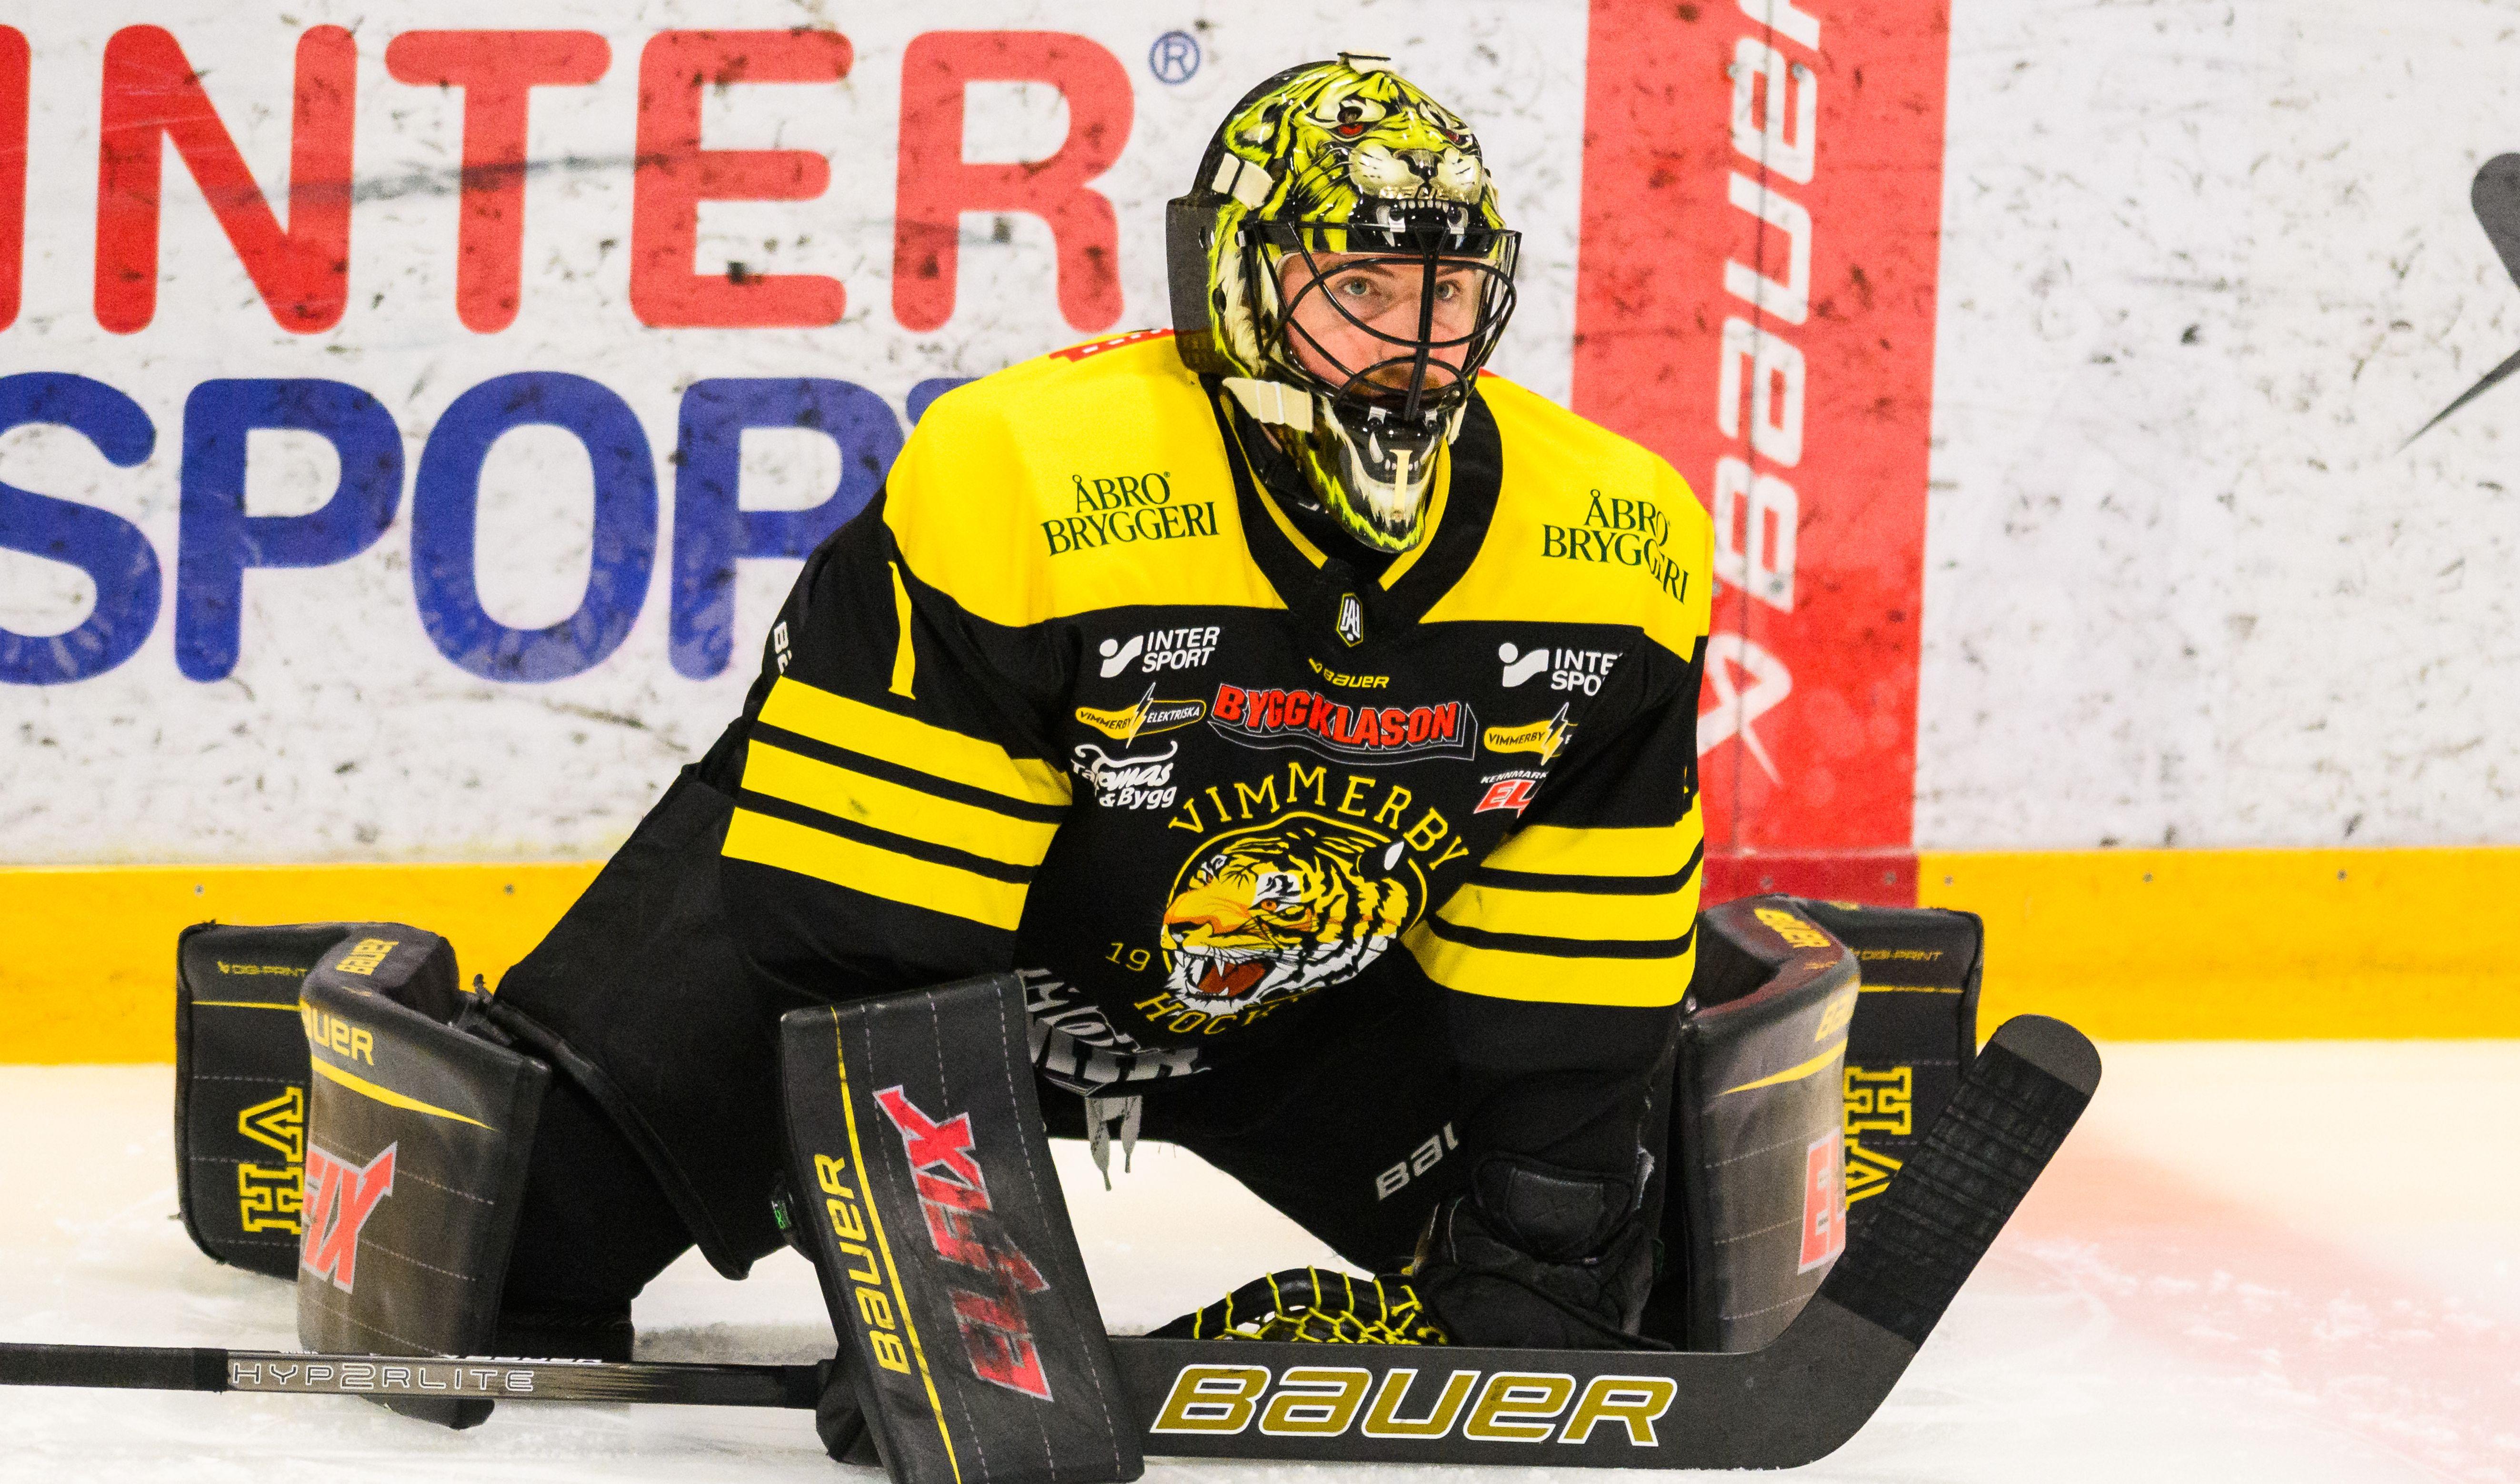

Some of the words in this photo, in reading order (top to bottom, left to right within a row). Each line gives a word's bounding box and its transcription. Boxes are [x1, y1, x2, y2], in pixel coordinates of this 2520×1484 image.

[1072, 471, 1170, 513] ÅBRO
[0, 371, 980, 684] SPOR
[1040, 501, 1220, 556] BRYGGERI
[889, 561, 916, 700] 1
[1147, 626, 1220, 652] INTER
[1142, 647, 1215, 673] SPORT
[1554, 648, 1623, 675] INTE
[1551, 670, 1606, 697] SPO
[1080, 710, 1133, 730] VIMMERBY
[1146, 707, 1200, 723] ELEKTRISKA
[1213, 685, 1460, 747] BYGGKLASON
[1489, 731, 1546, 745] VIMMERBY
[1099, 793, 1116, 807] &
[1117, 786, 1177, 810] Bygg
[1168, 762, 1469, 871] VIMMERBY
[1105, 942, 1150, 971] 19
[232, 1362, 535, 1393] HYP2RLITE
